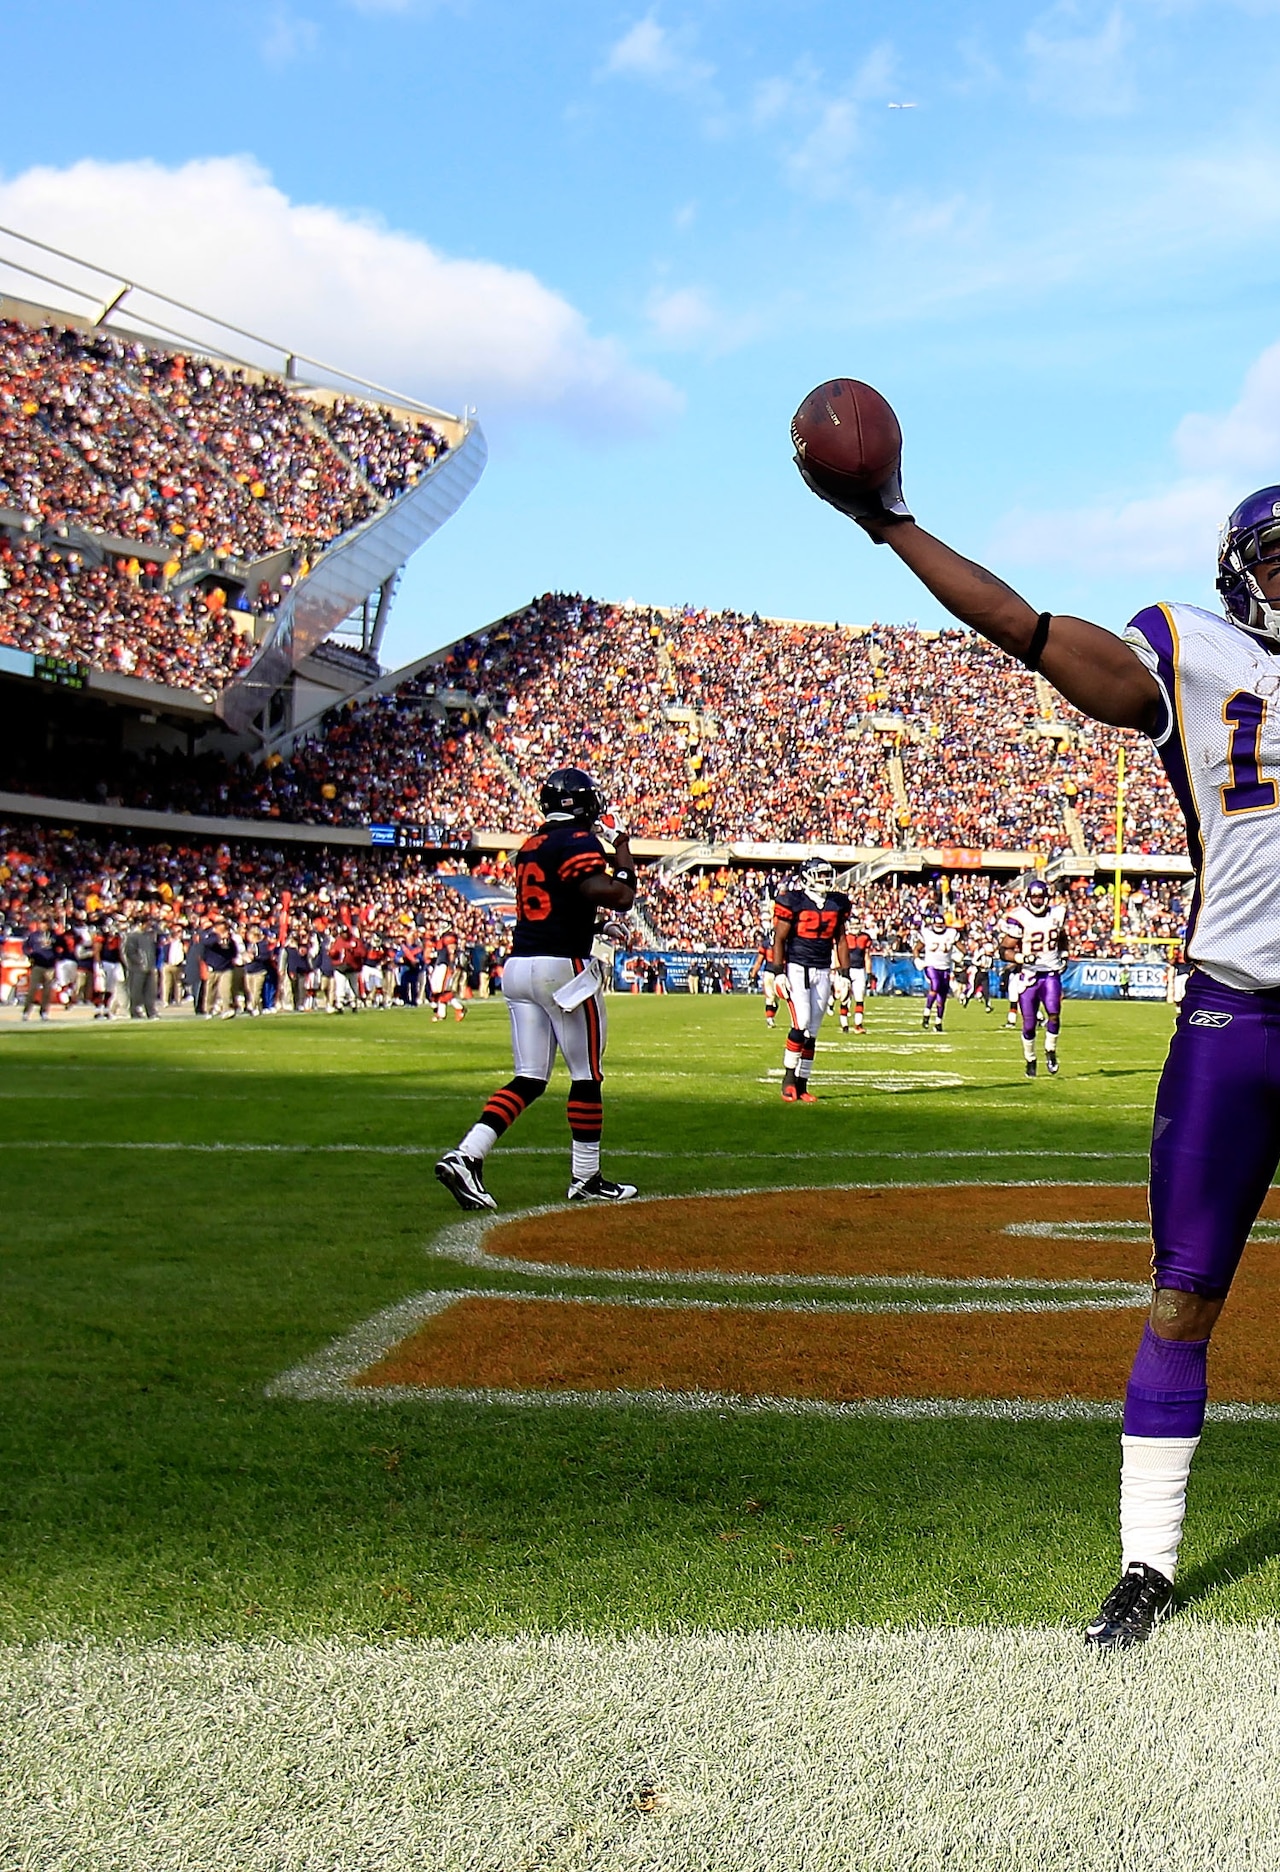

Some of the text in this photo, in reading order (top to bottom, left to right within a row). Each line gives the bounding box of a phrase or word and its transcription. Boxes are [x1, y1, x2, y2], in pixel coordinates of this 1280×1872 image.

[797, 910, 838, 938] 27
[1031, 928, 1059, 952] 28
[1086, 968, 1161, 984] MONTERS
